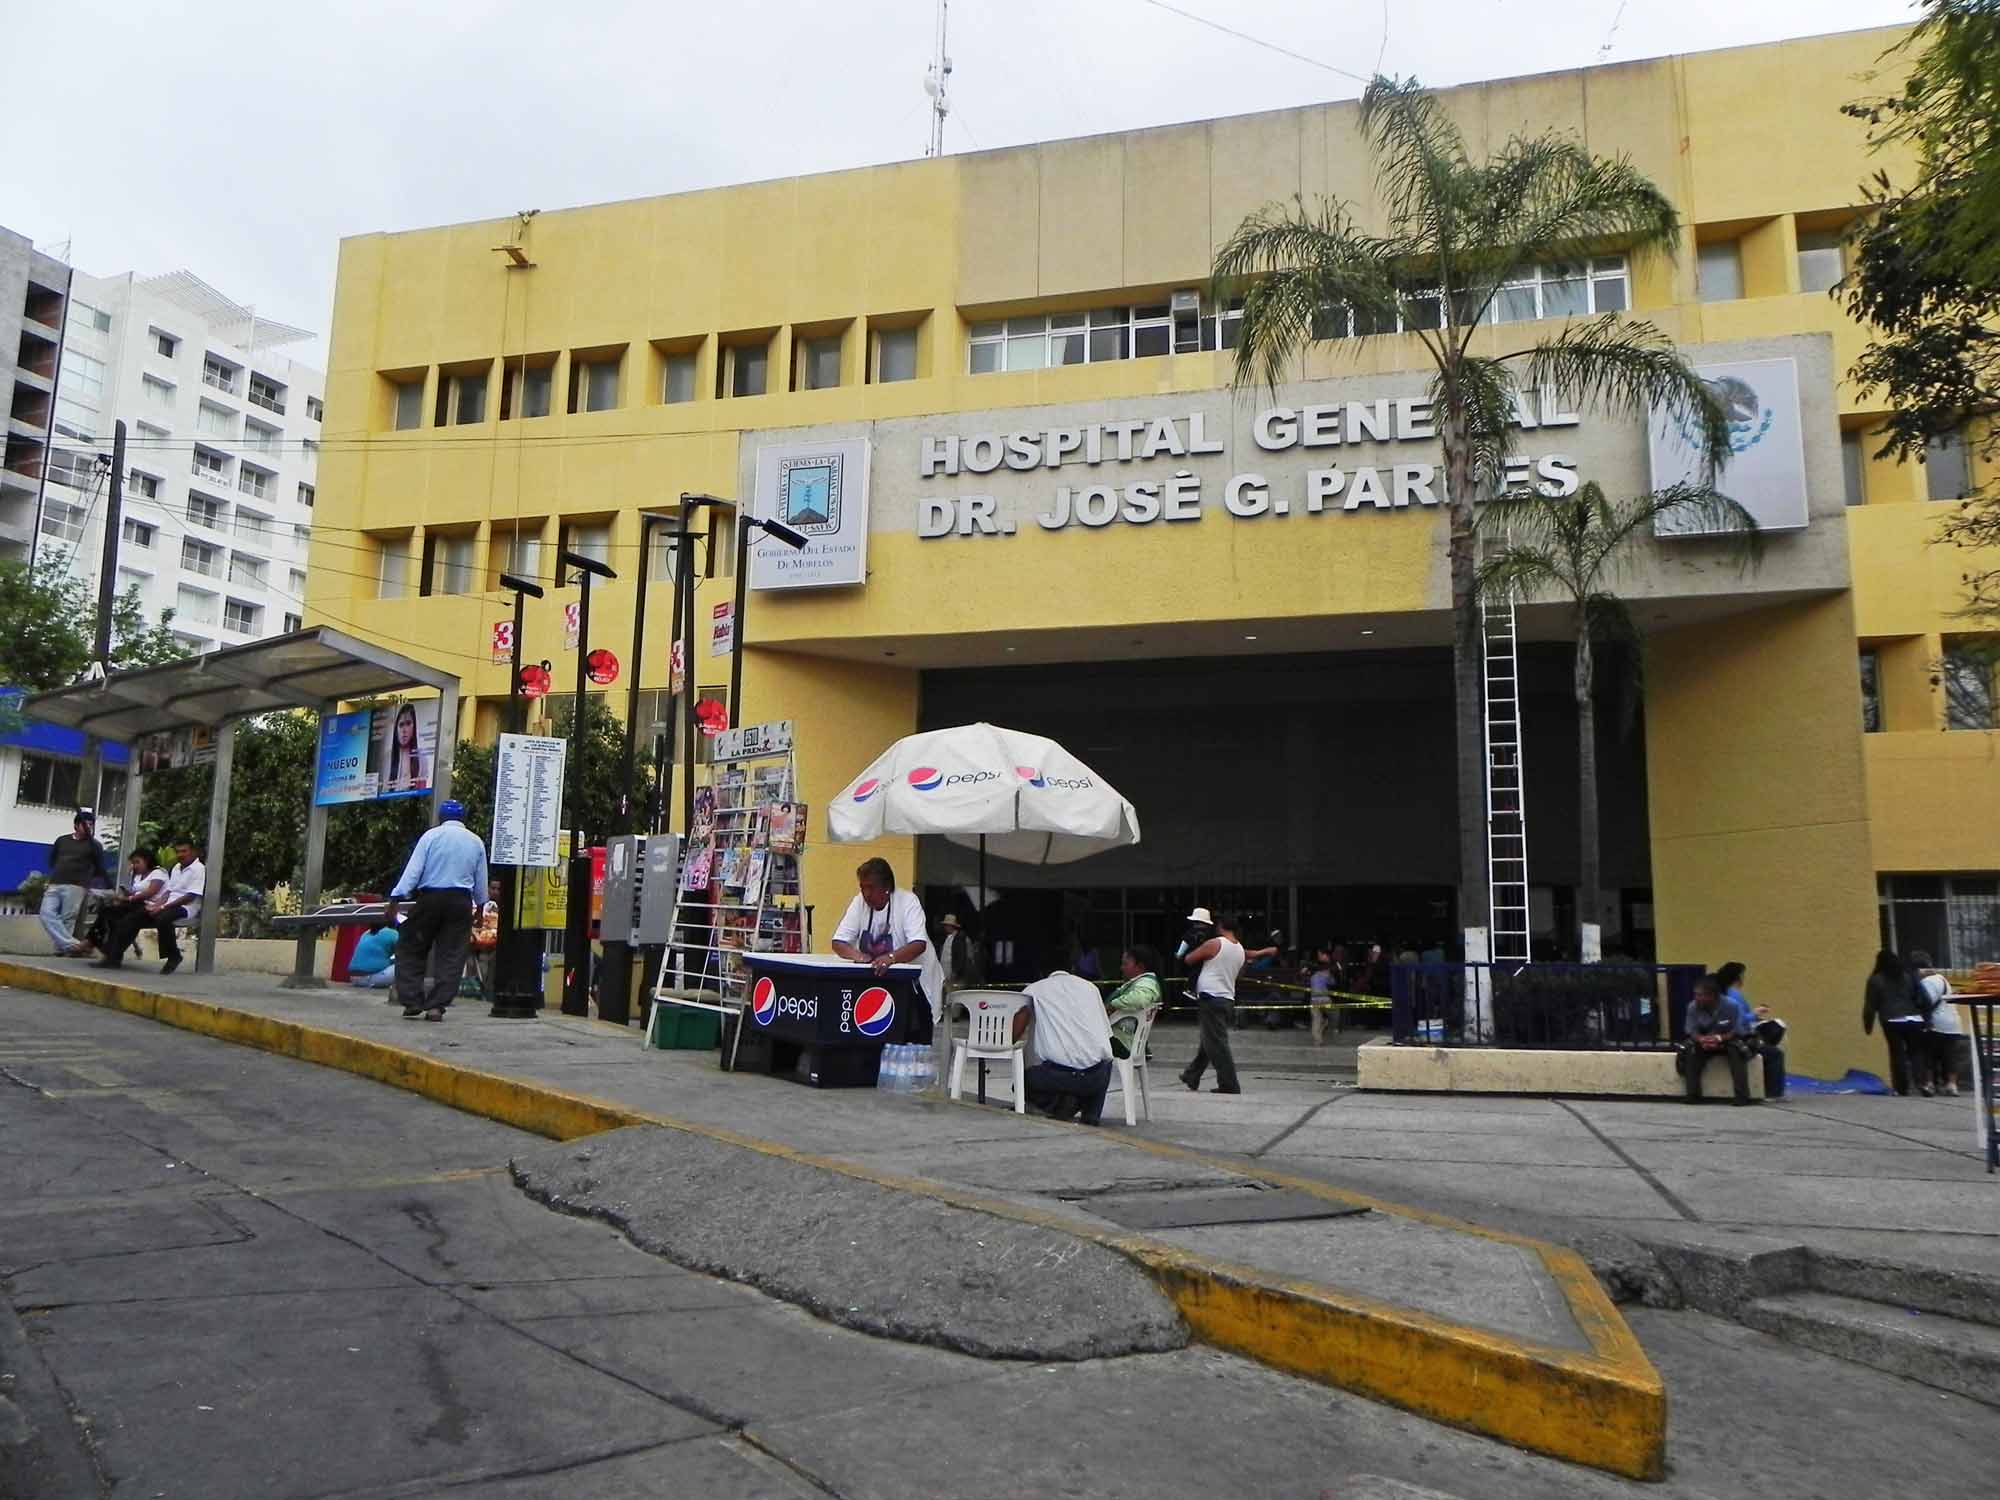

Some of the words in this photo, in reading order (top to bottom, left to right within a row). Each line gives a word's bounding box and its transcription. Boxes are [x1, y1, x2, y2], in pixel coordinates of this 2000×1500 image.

[921, 412, 1224, 478] HOSPITAL
[1253, 384, 1582, 450] GENEAL
[918, 494, 1017, 538] DR.
[1036, 470, 1201, 530] JOSÉ
[1224, 472, 1289, 518] G.
[1307, 453, 1580, 513] PARES
[822, 543, 856, 555] ESTADO
[792, 559, 834, 570] MORELOS
[328, 757, 359, 770] NUEVO
[945, 770, 1002, 786] pepsi
[1046, 775, 1094, 790] pepsi
[777, 995, 818, 1020] pepsi
[840, 989, 853, 1033] pepsi
